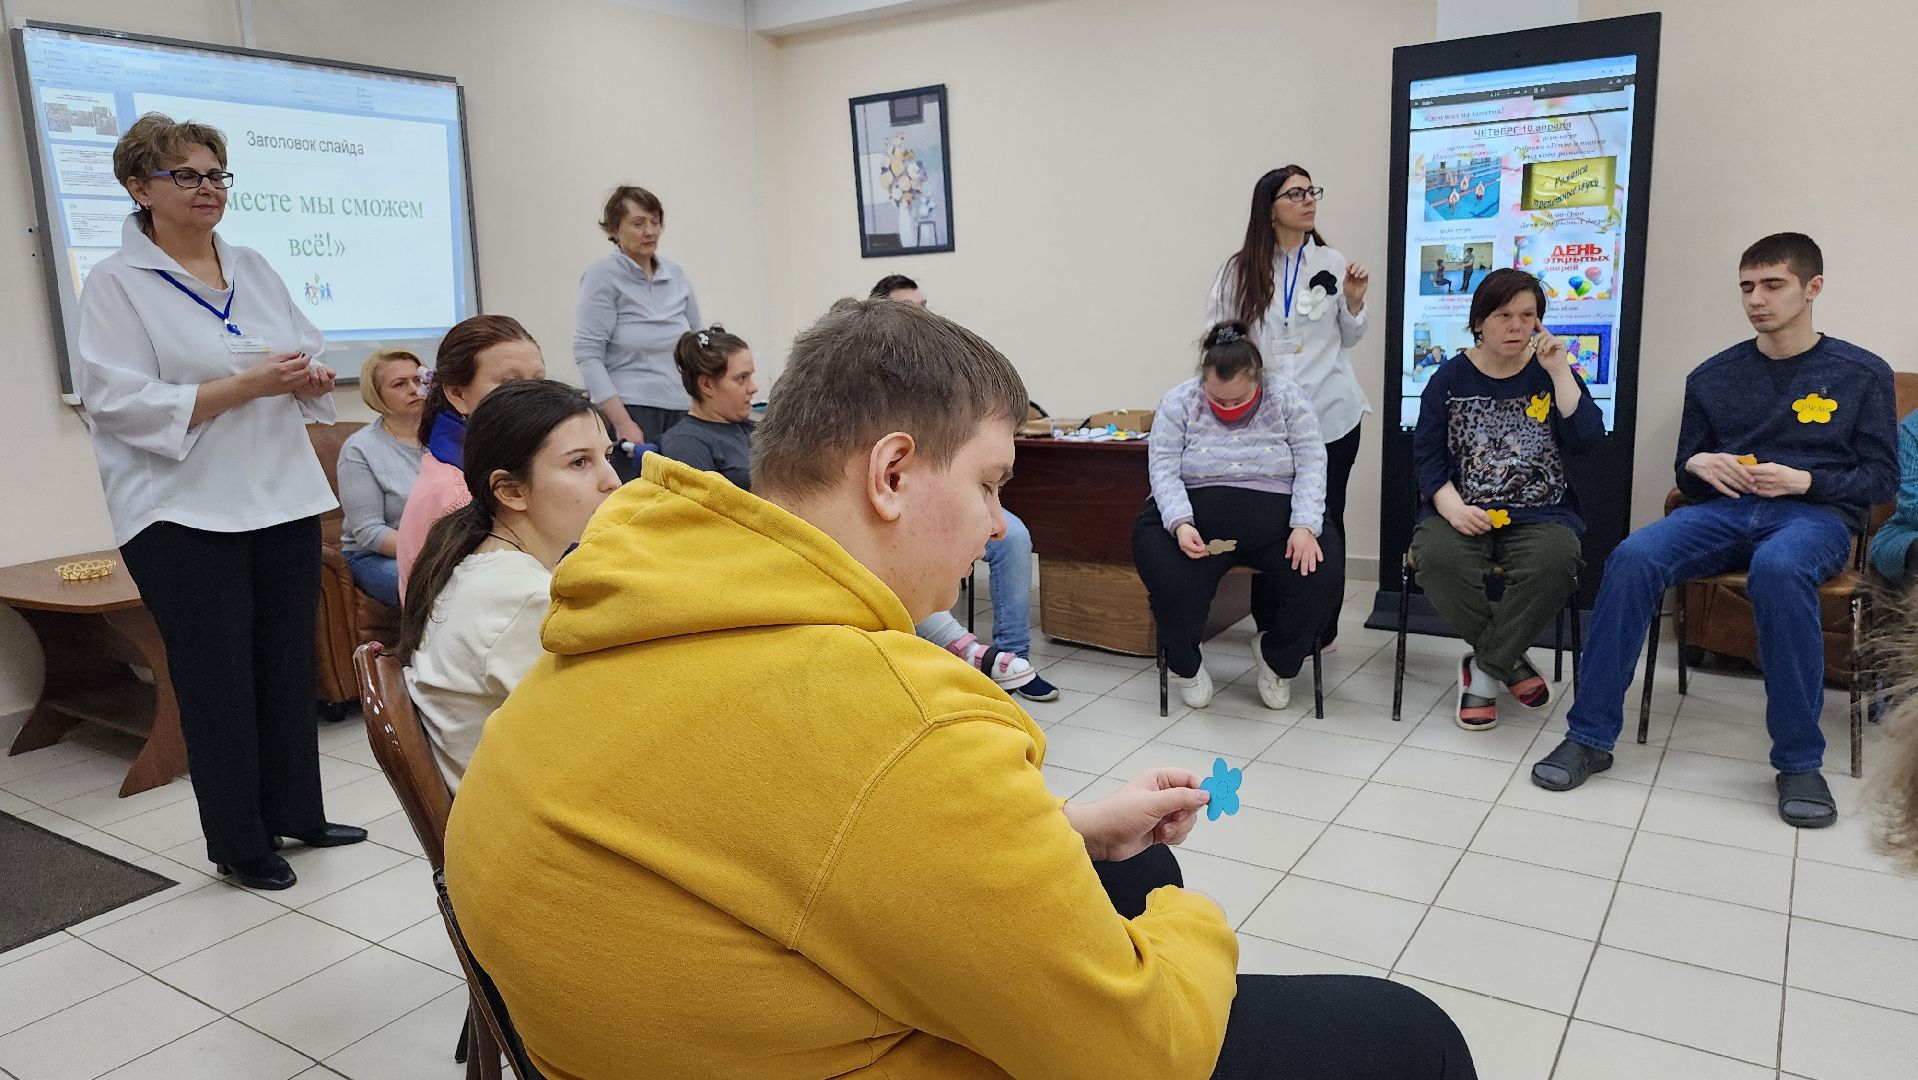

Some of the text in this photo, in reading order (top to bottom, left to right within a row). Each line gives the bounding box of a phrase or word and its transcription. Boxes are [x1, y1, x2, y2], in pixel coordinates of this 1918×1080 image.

[1474, 121, 1572, 138] ЧЕТВЕРГ 10 апреля
[246, 130, 364, 157] Заголовок слайда
[227, 191, 424, 219] месте мы сможем
[288, 232, 346, 257] всё!»
[1551, 243, 1602, 257] ДЕНЬ
[1543, 255, 1610, 265] открытых
